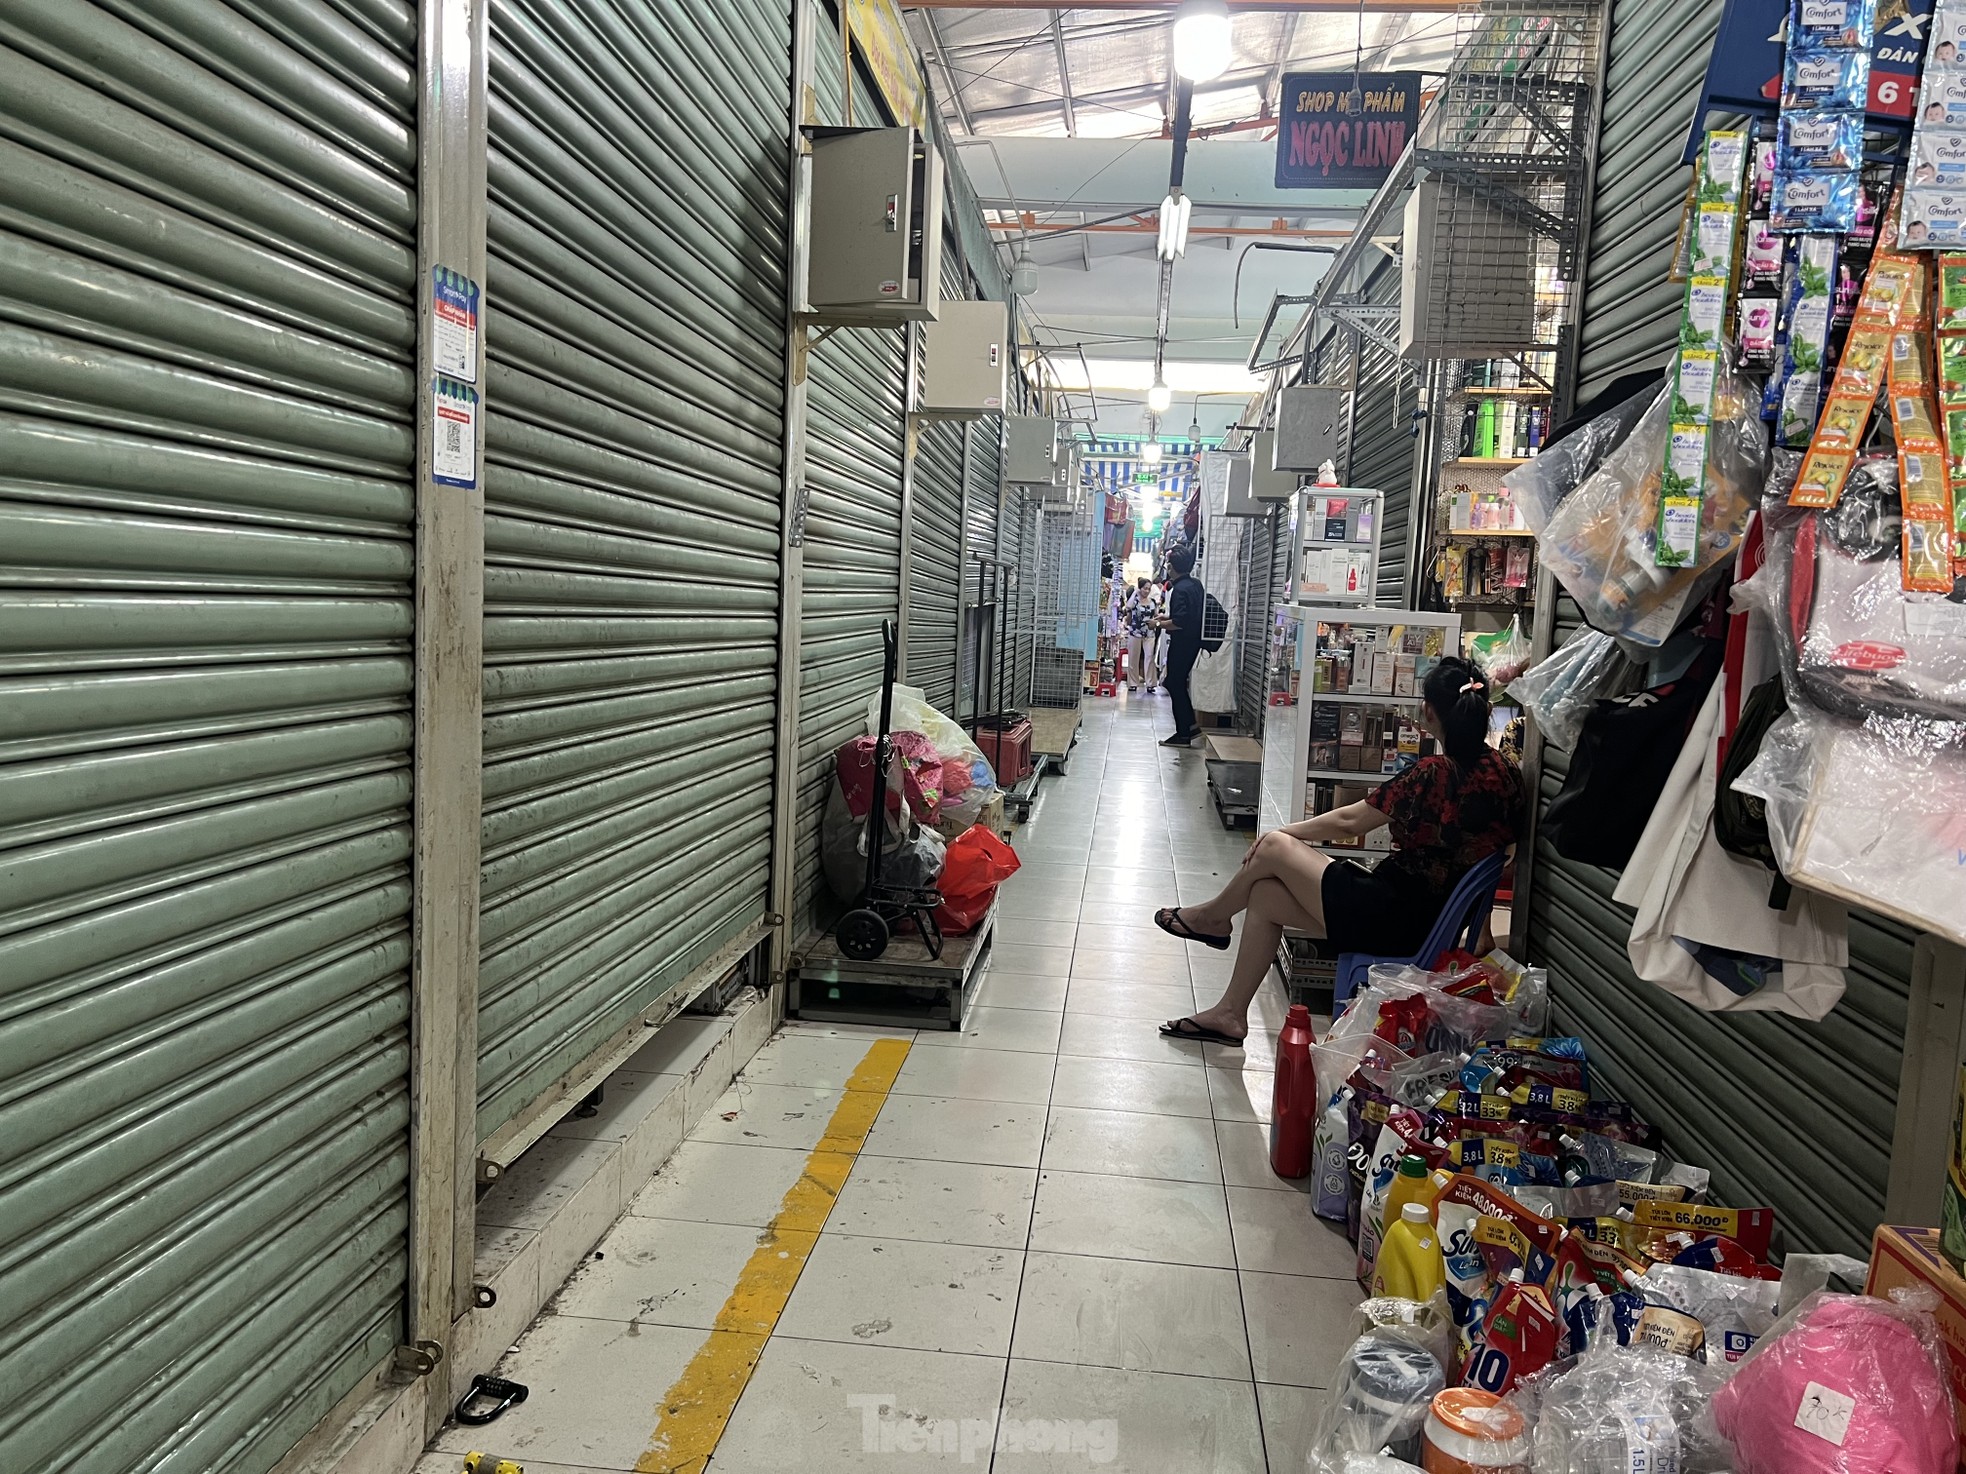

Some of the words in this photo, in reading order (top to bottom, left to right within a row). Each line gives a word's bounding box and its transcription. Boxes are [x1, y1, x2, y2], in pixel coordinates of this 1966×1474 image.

[1806, 6, 1842, 19] Comfort
[1878, 81, 1900, 104] 6
[1947, 86, 1966, 99] Comf
[1296, 91, 1335, 113] SHOP
[1288, 121, 1350, 176] NGỌC
[1352, 121, 1406, 167] LINH
[1936, 147, 1966, 159] Comfor
[1787, 187, 1825, 200] Comfort
[1928, 205, 1963, 217] Comfort
[1813, 461, 1843, 470] Rejoice
[1463, 1150, 1477, 1162] 3,8
[1478, 1150, 1484, 1160] L
[1467, 1343, 1510, 1393] 10
